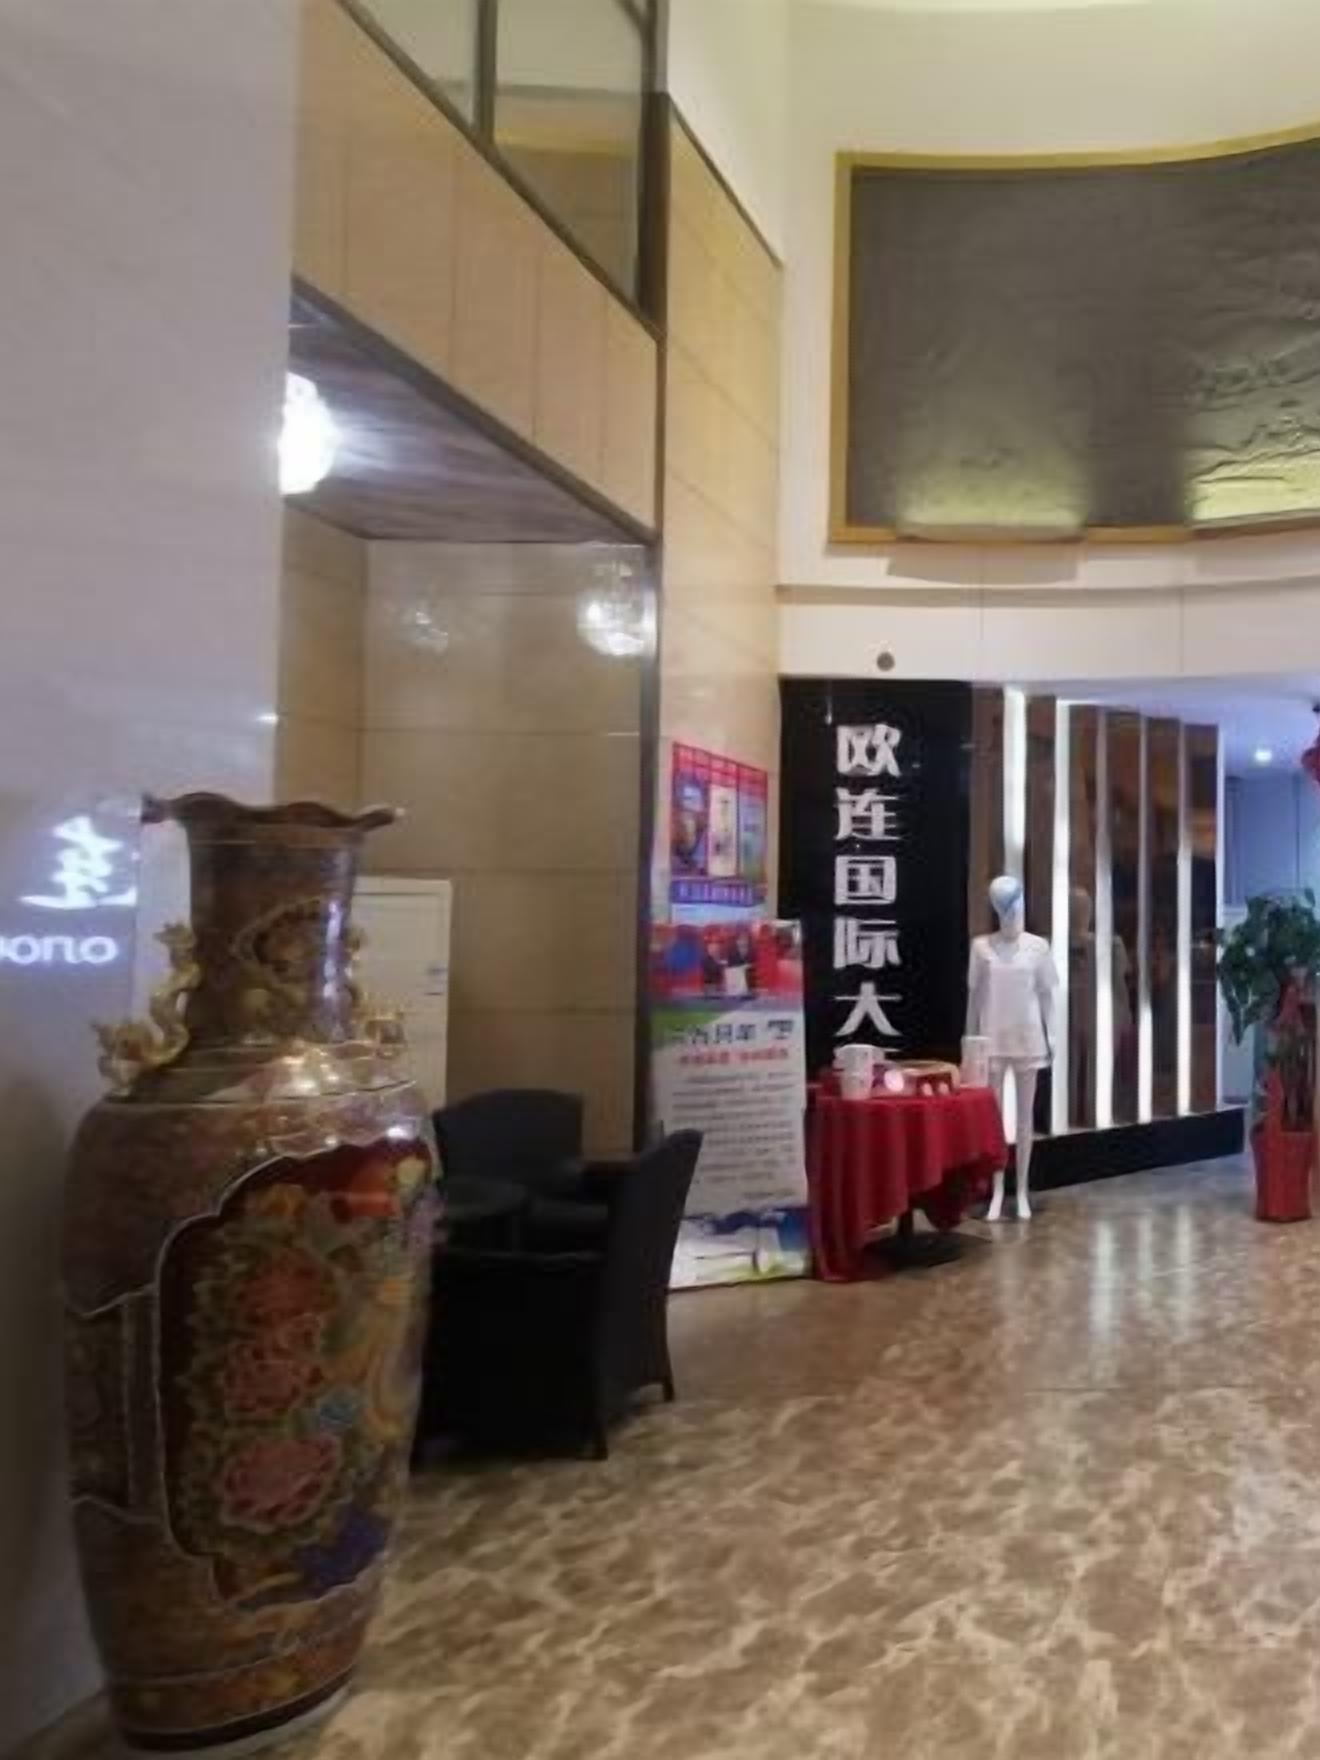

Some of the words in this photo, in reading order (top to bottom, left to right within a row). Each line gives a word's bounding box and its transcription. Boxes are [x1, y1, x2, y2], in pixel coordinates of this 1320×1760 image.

[834, 723, 902, 1052] 欧连国际大
